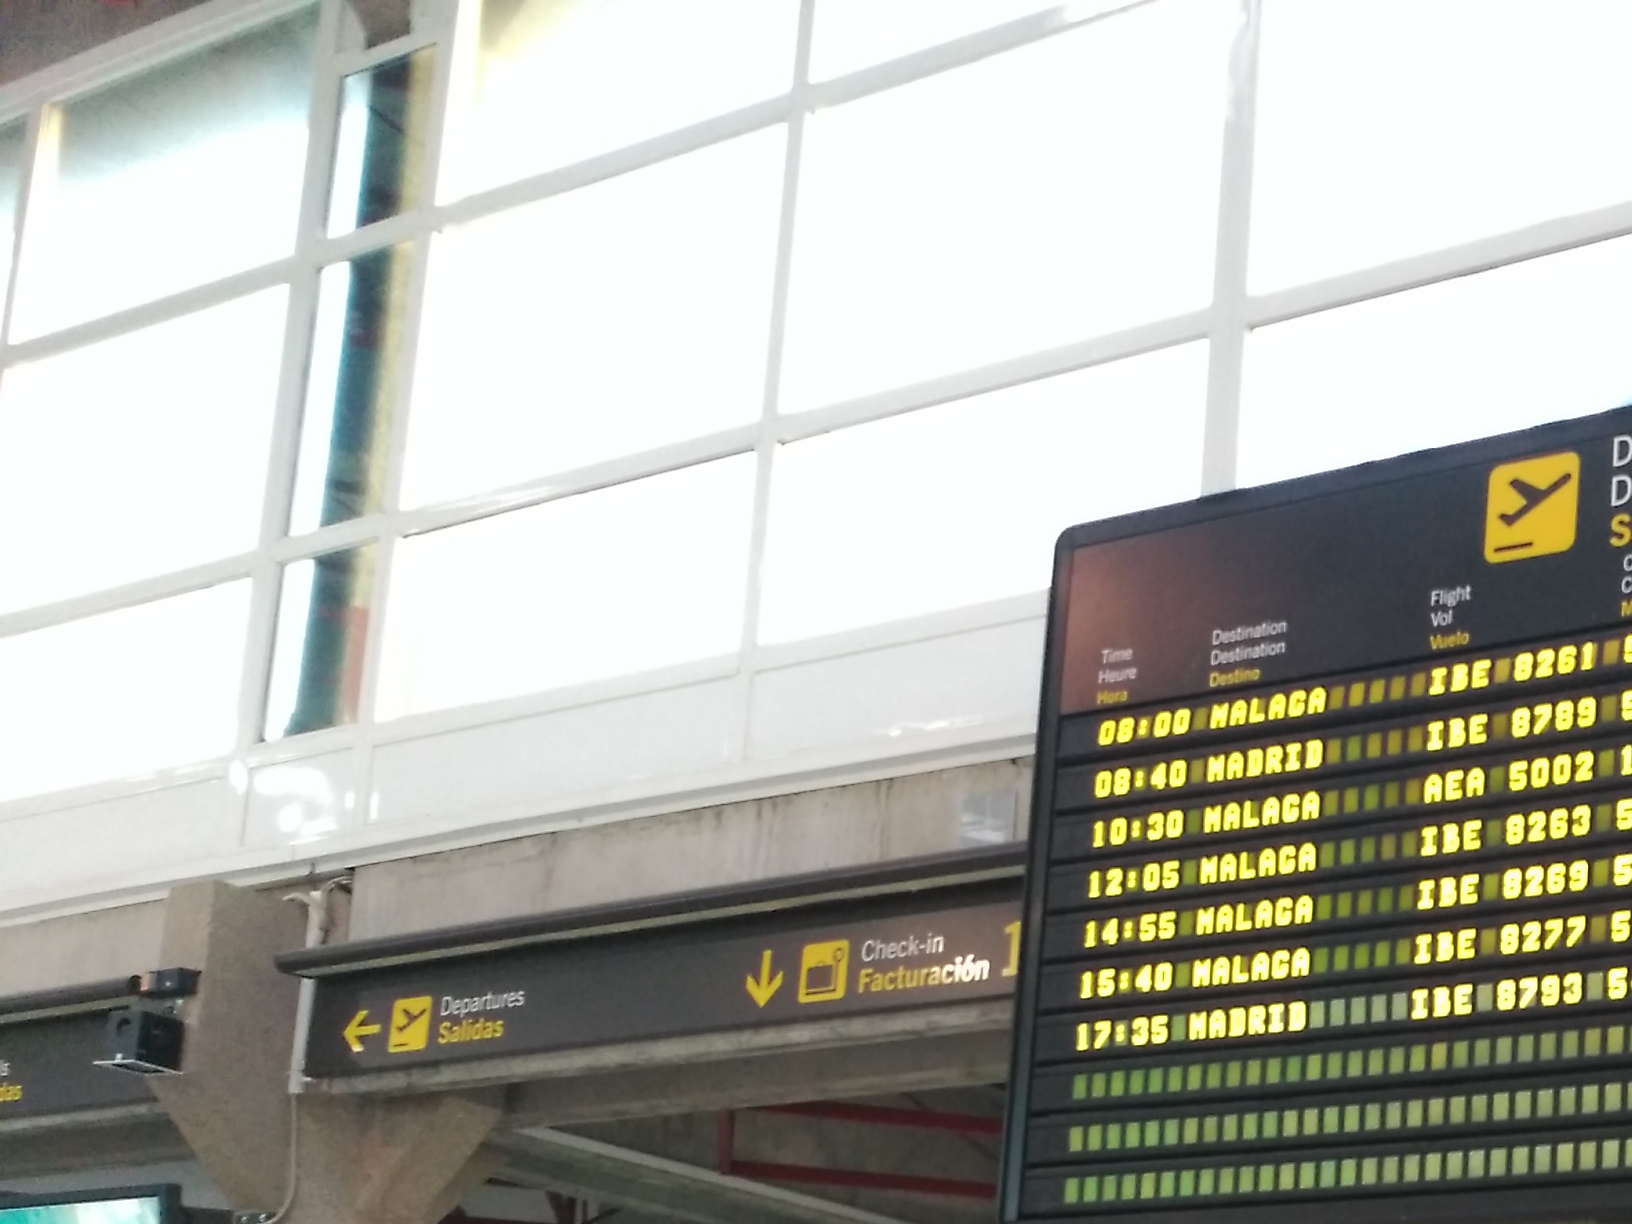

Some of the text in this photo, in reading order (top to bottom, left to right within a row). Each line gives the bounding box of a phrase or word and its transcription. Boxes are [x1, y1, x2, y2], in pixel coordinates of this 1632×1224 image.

[1430, 585, 1472, 608] Flight
[1430, 610, 1453, 627] Vol
[1212, 620, 1288, 646] Destination
[1429, 631, 1470, 650] Vuelo
[1101, 647, 1133, 664] Time
[1210, 641, 1286, 666] Destination
[1098, 667, 1137, 684] Heure
[1209, 667, 1261, 687] Destino
[1098, 709, 1191, 746] 08:00
[1210, 687, 1326, 729] MALAGA
[1429, 659, 1491, 695] IBE
[1514, 642, 1594, 681] 8261
[1095, 760, 1187, 798] 08:40
[1207, 739, 1323, 783] MADRID
[1427, 714, 1488, 751] IBE
[1511, 697, 1596, 738] 8789
[1093, 810, 1183, 848] 10:30
[1204, 791, 1320, 833] MALAGA
[1424, 767, 1485, 804] AEA
[1509, 751, 1594, 791] 5002
[1089, 860, 1179, 898] 12:05
[1200, 843, 1316, 884] MALAGA
[1421, 820, 1482, 856] IBE
[1506, 805, 1591, 845] 8263
[1084, 911, 1176, 948] 14:55
[1196, 895, 1313, 935] MALAGA
[1417, 874, 1480, 910] IBE
[1503, 860, 1589, 899] 8269
[860, 932, 945, 963] Check-in
[1080, 962, 1173, 999] 15:40
[1192, 948, 1310, 987] MALAGA
[1414, 928, 1476, 964] IBE
[1500, 915, 1586, 955] 8277
[858, 954, 991, 994] Facturación
[440, 990, 525, 1018] Departures
[1076, 1015, 1168, 1051] 17:35
[1189, 1001, 1306, 1040] MADRID
[1411, 984, 1473, 1020] IBE
[1497, 972, 1582, 1011] 8793
[438, 1018, 504, 1044] Salidas
